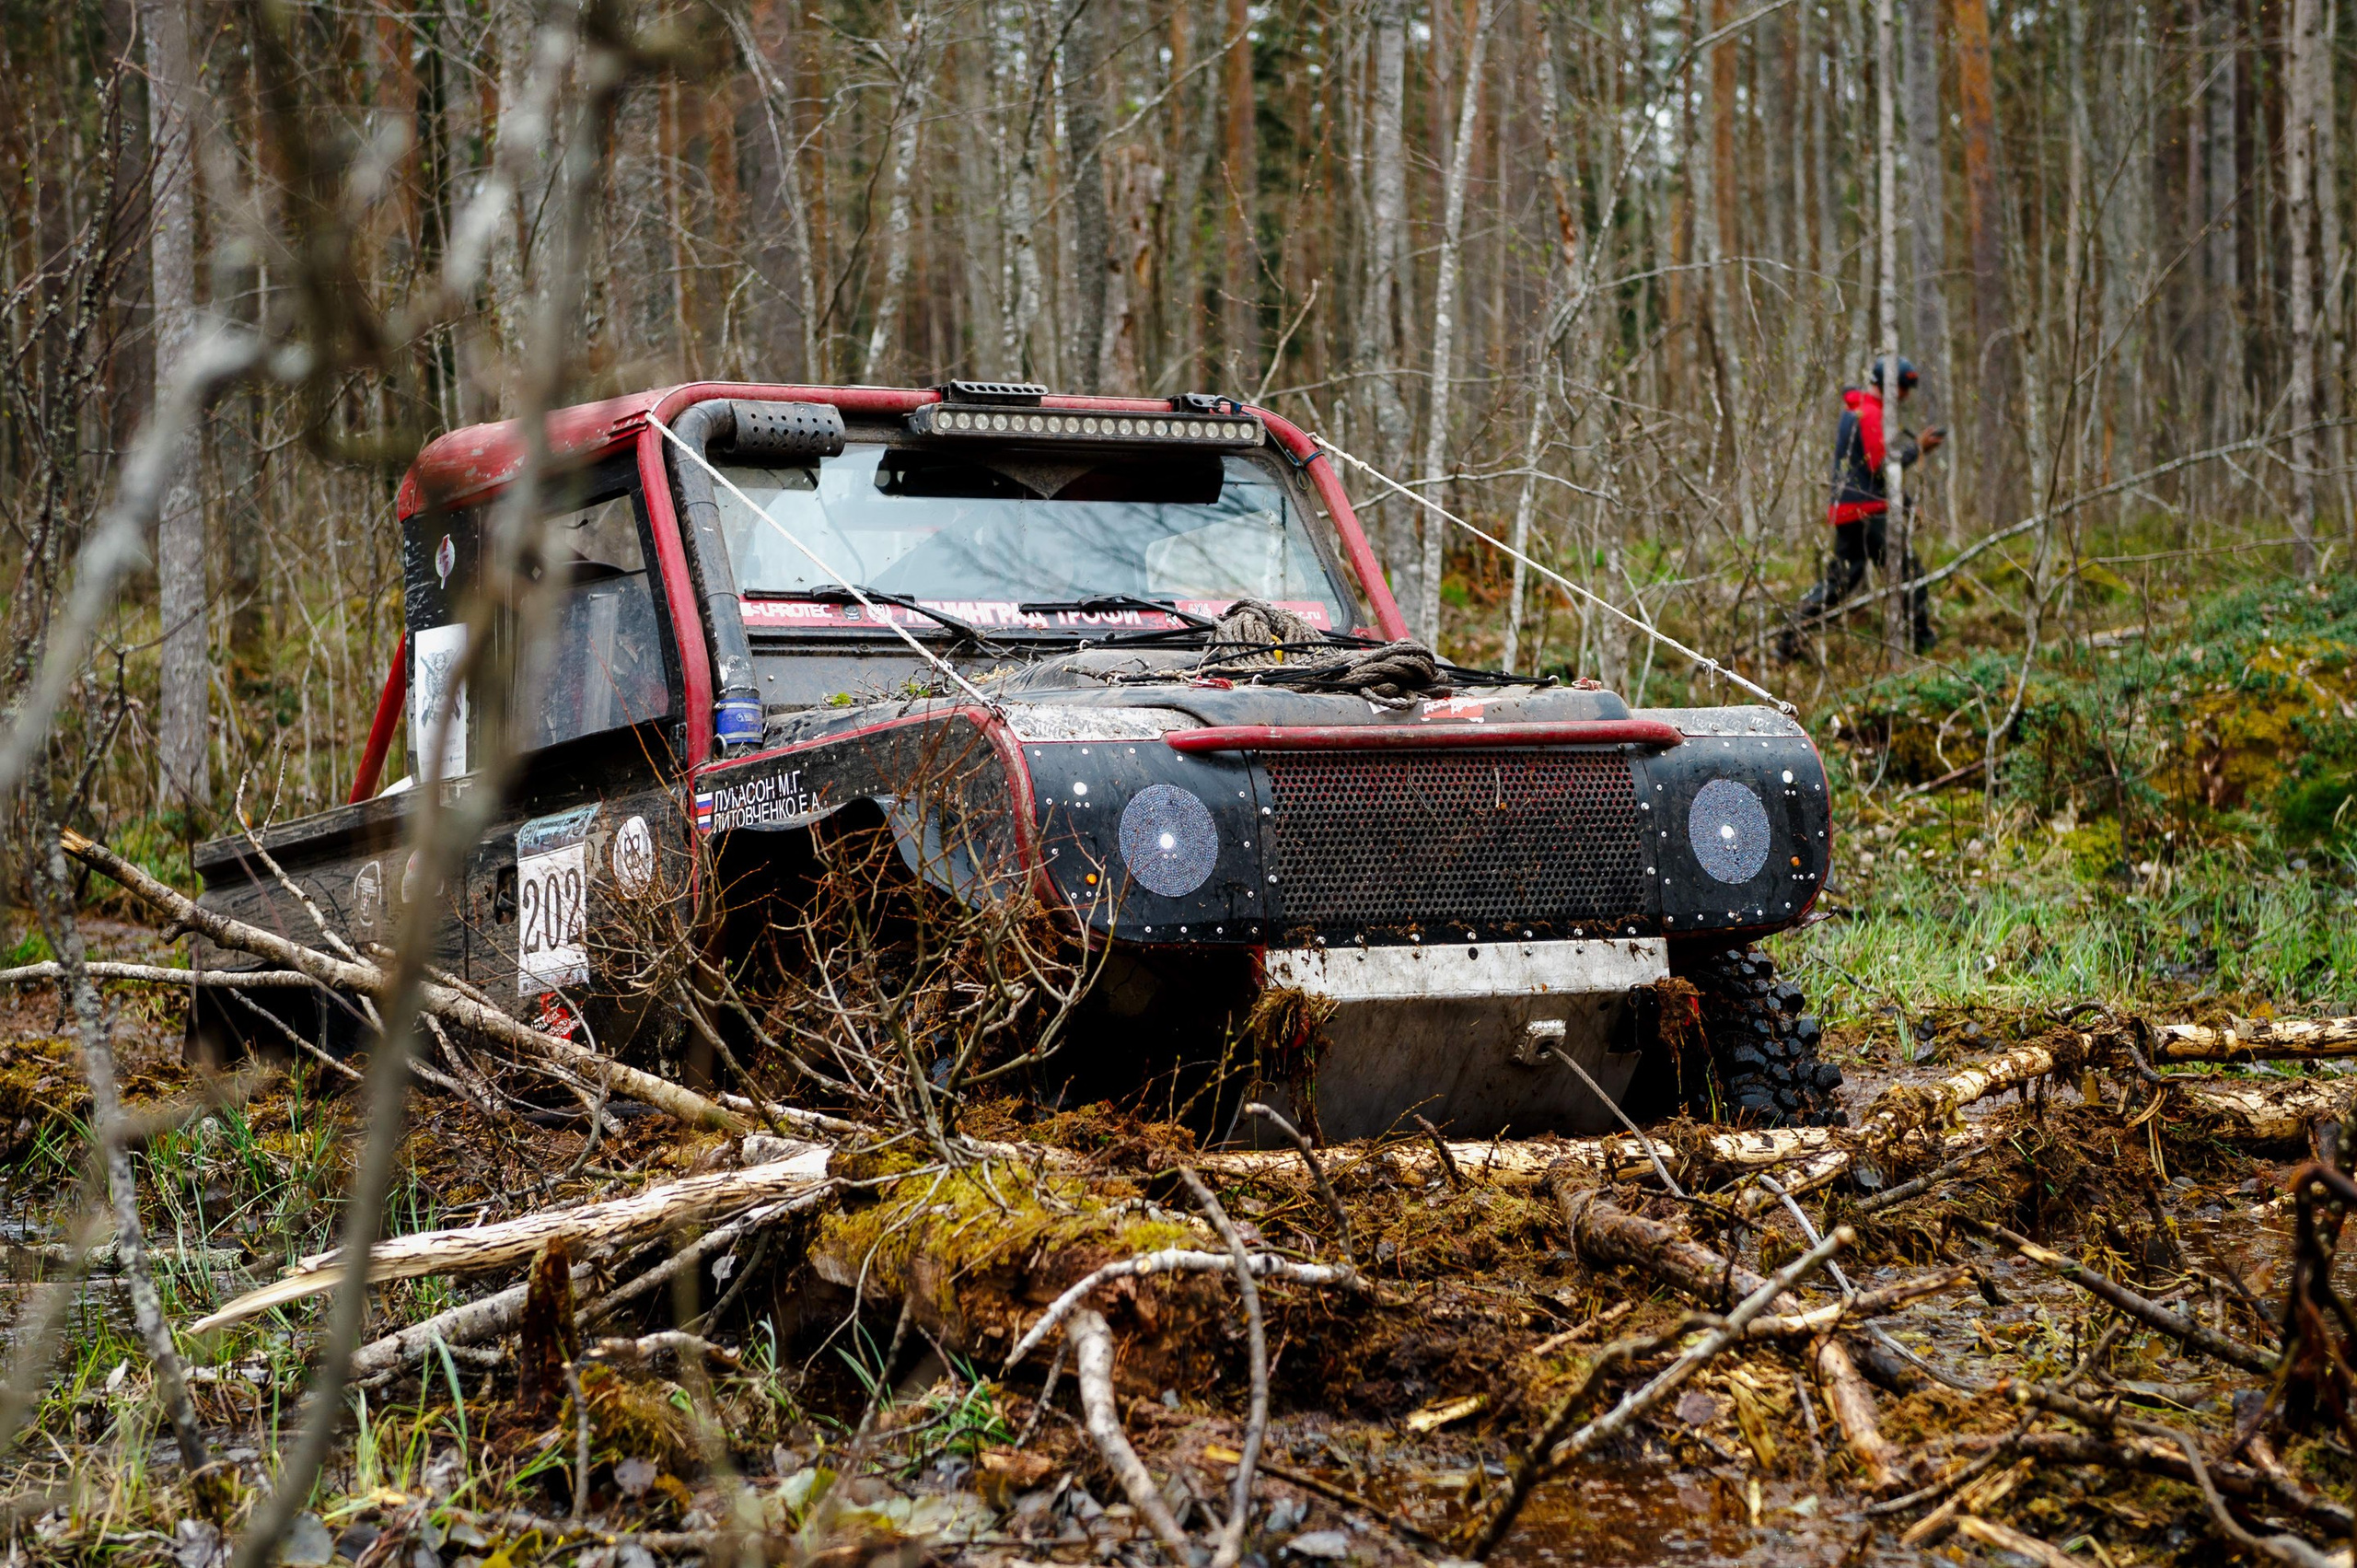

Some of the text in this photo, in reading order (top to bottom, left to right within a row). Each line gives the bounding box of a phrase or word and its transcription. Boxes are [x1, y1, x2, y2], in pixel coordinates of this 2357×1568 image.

[751, 603, 832, 618] SUPROTEC
[714, 777, 775, 813] ЛУКАСОН
[713, 797, 796, 834] ЛИТОВЧЕНКО
[522, 867, 583, 955] 202
